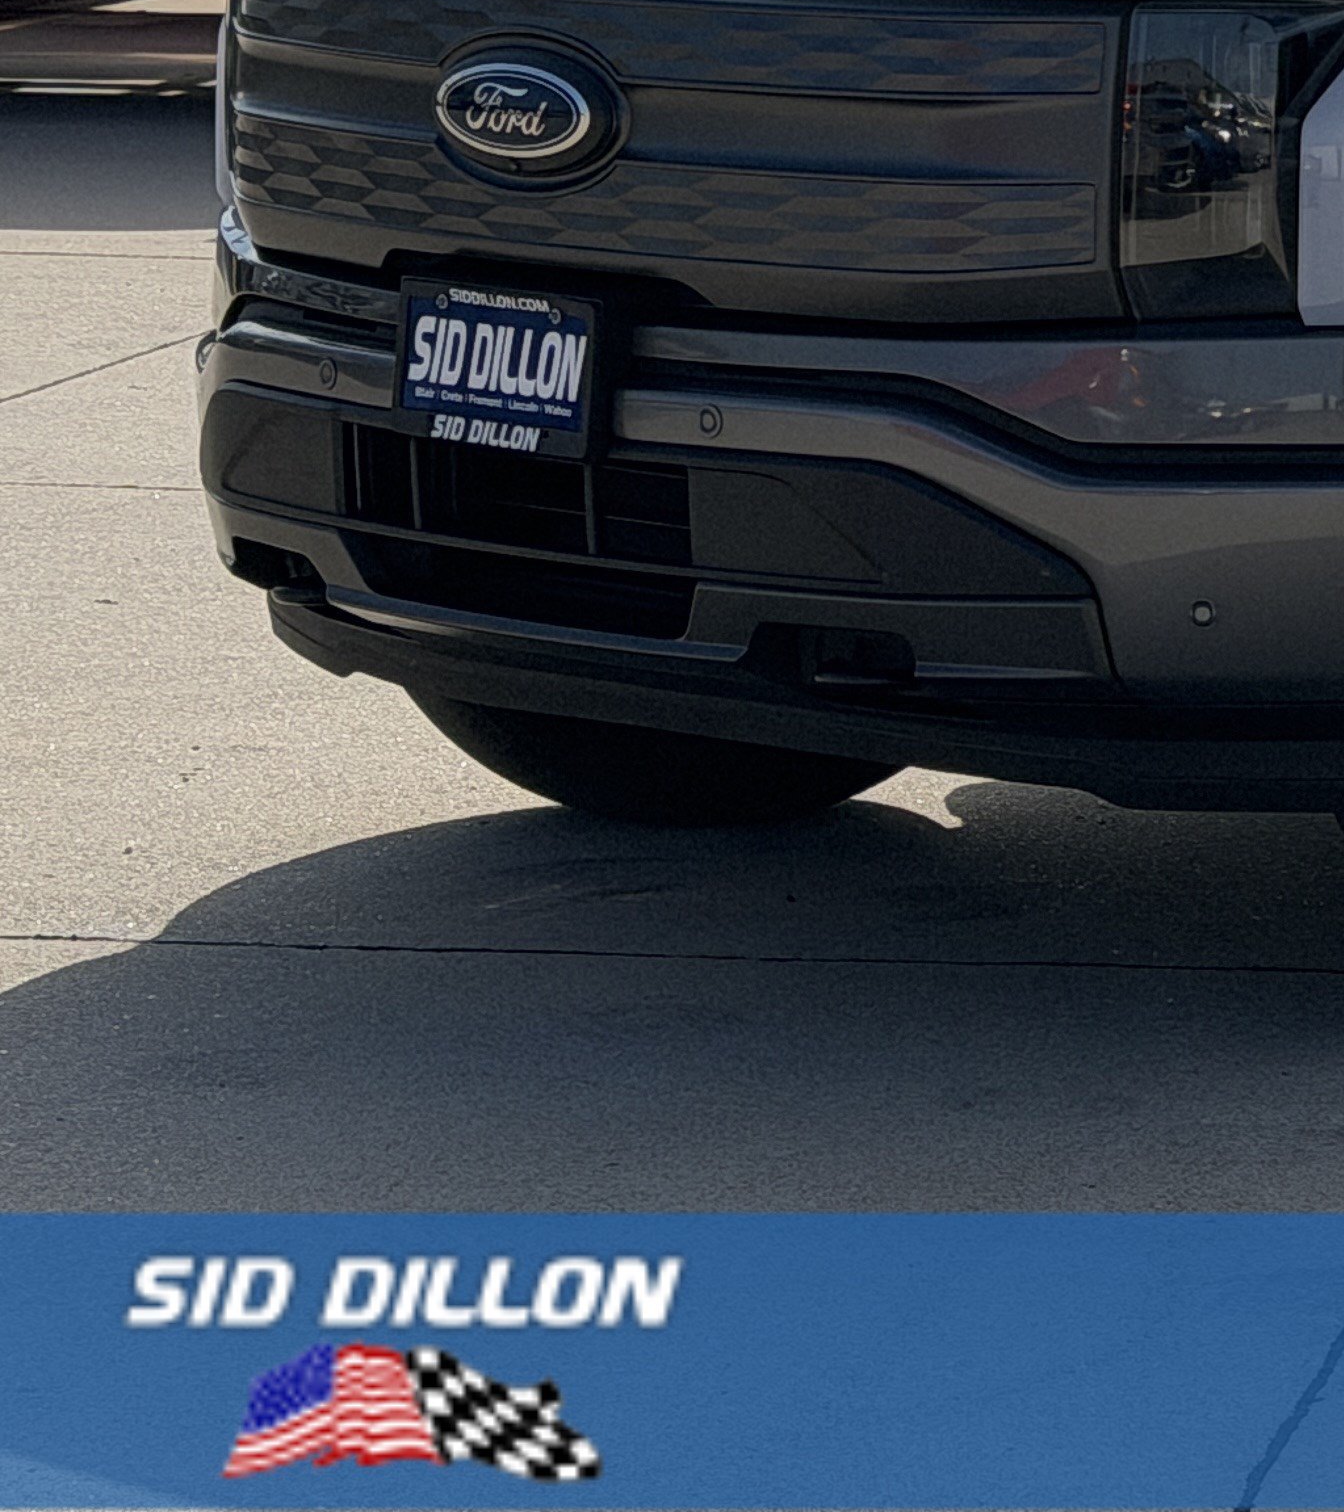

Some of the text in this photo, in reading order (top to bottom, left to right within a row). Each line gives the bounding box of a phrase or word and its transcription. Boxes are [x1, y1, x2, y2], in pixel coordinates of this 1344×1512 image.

[465, 82, 548, 136] Ford
[449, 288, 550, 313] SIDDILLON.COM
[407, 315, 588, 403] SID DILLON
[430, 414, 541, 453] SID DILLON
